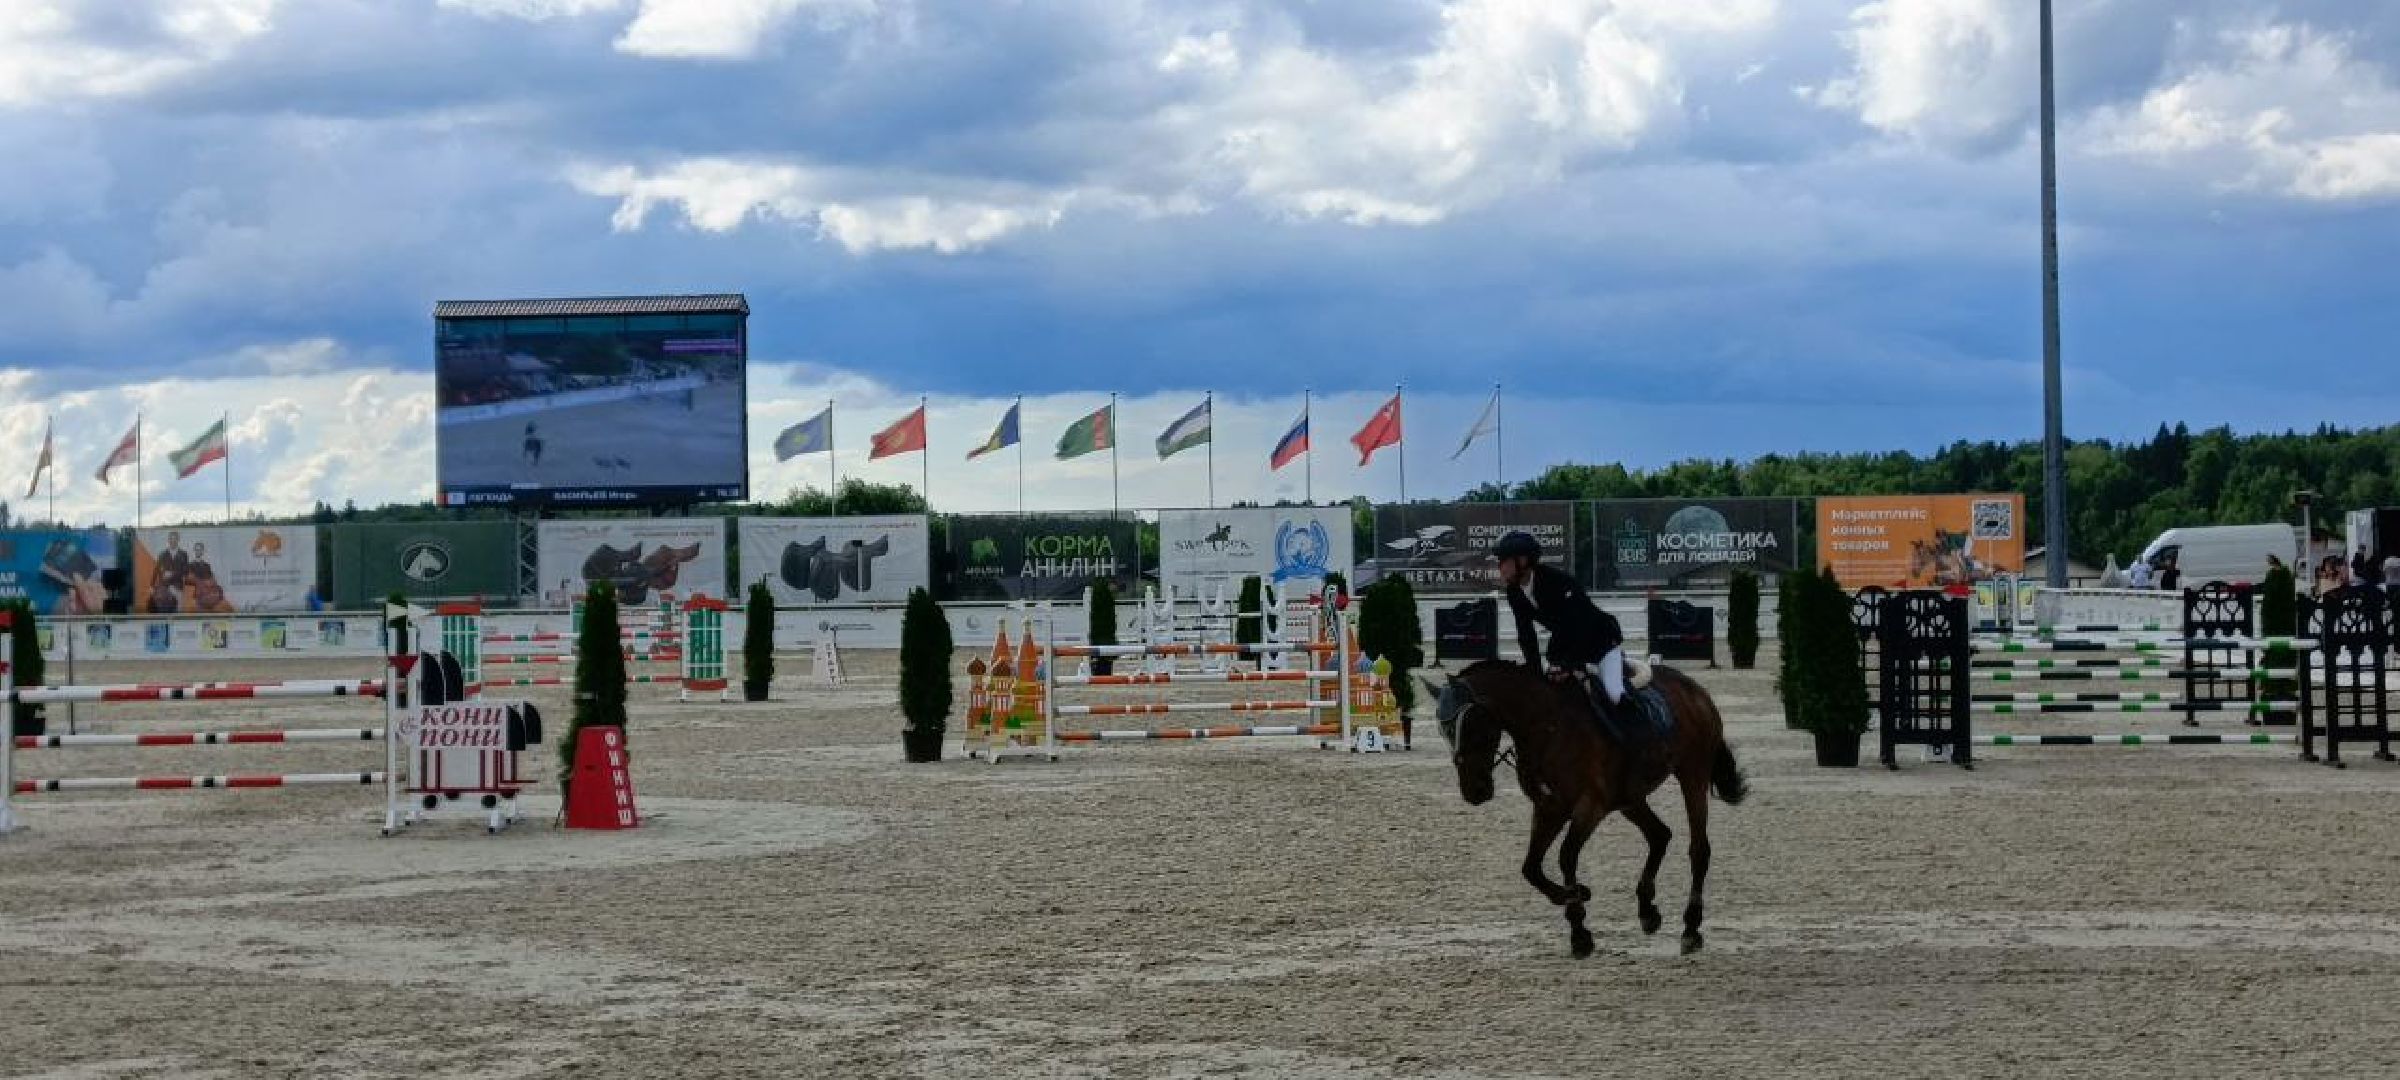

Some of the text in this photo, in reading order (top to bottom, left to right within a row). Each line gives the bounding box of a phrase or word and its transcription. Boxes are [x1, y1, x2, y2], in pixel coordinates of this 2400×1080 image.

[1831, 508, 1928, 521] Маркетплейс
[1831, 524, 1888, 536] конных
[1024, 535, 1114, 556] КОРМА
[1656, 531, 1777, 549] КОСМЕТИКА
[1831, 540, 1889, 552] товаров
[1656, 548, 1756, 565] ДЛЯ ЛОШАДЕЙ
[1020, 557, 1116, 578] АНИЛИН
[421, 707, 502, 725] КОНИ
[420, 728, 501, 746] ПОНИ
[1366, 730, 1375, 747] 9
[604, 731, 632, 826] ФИНИШ
